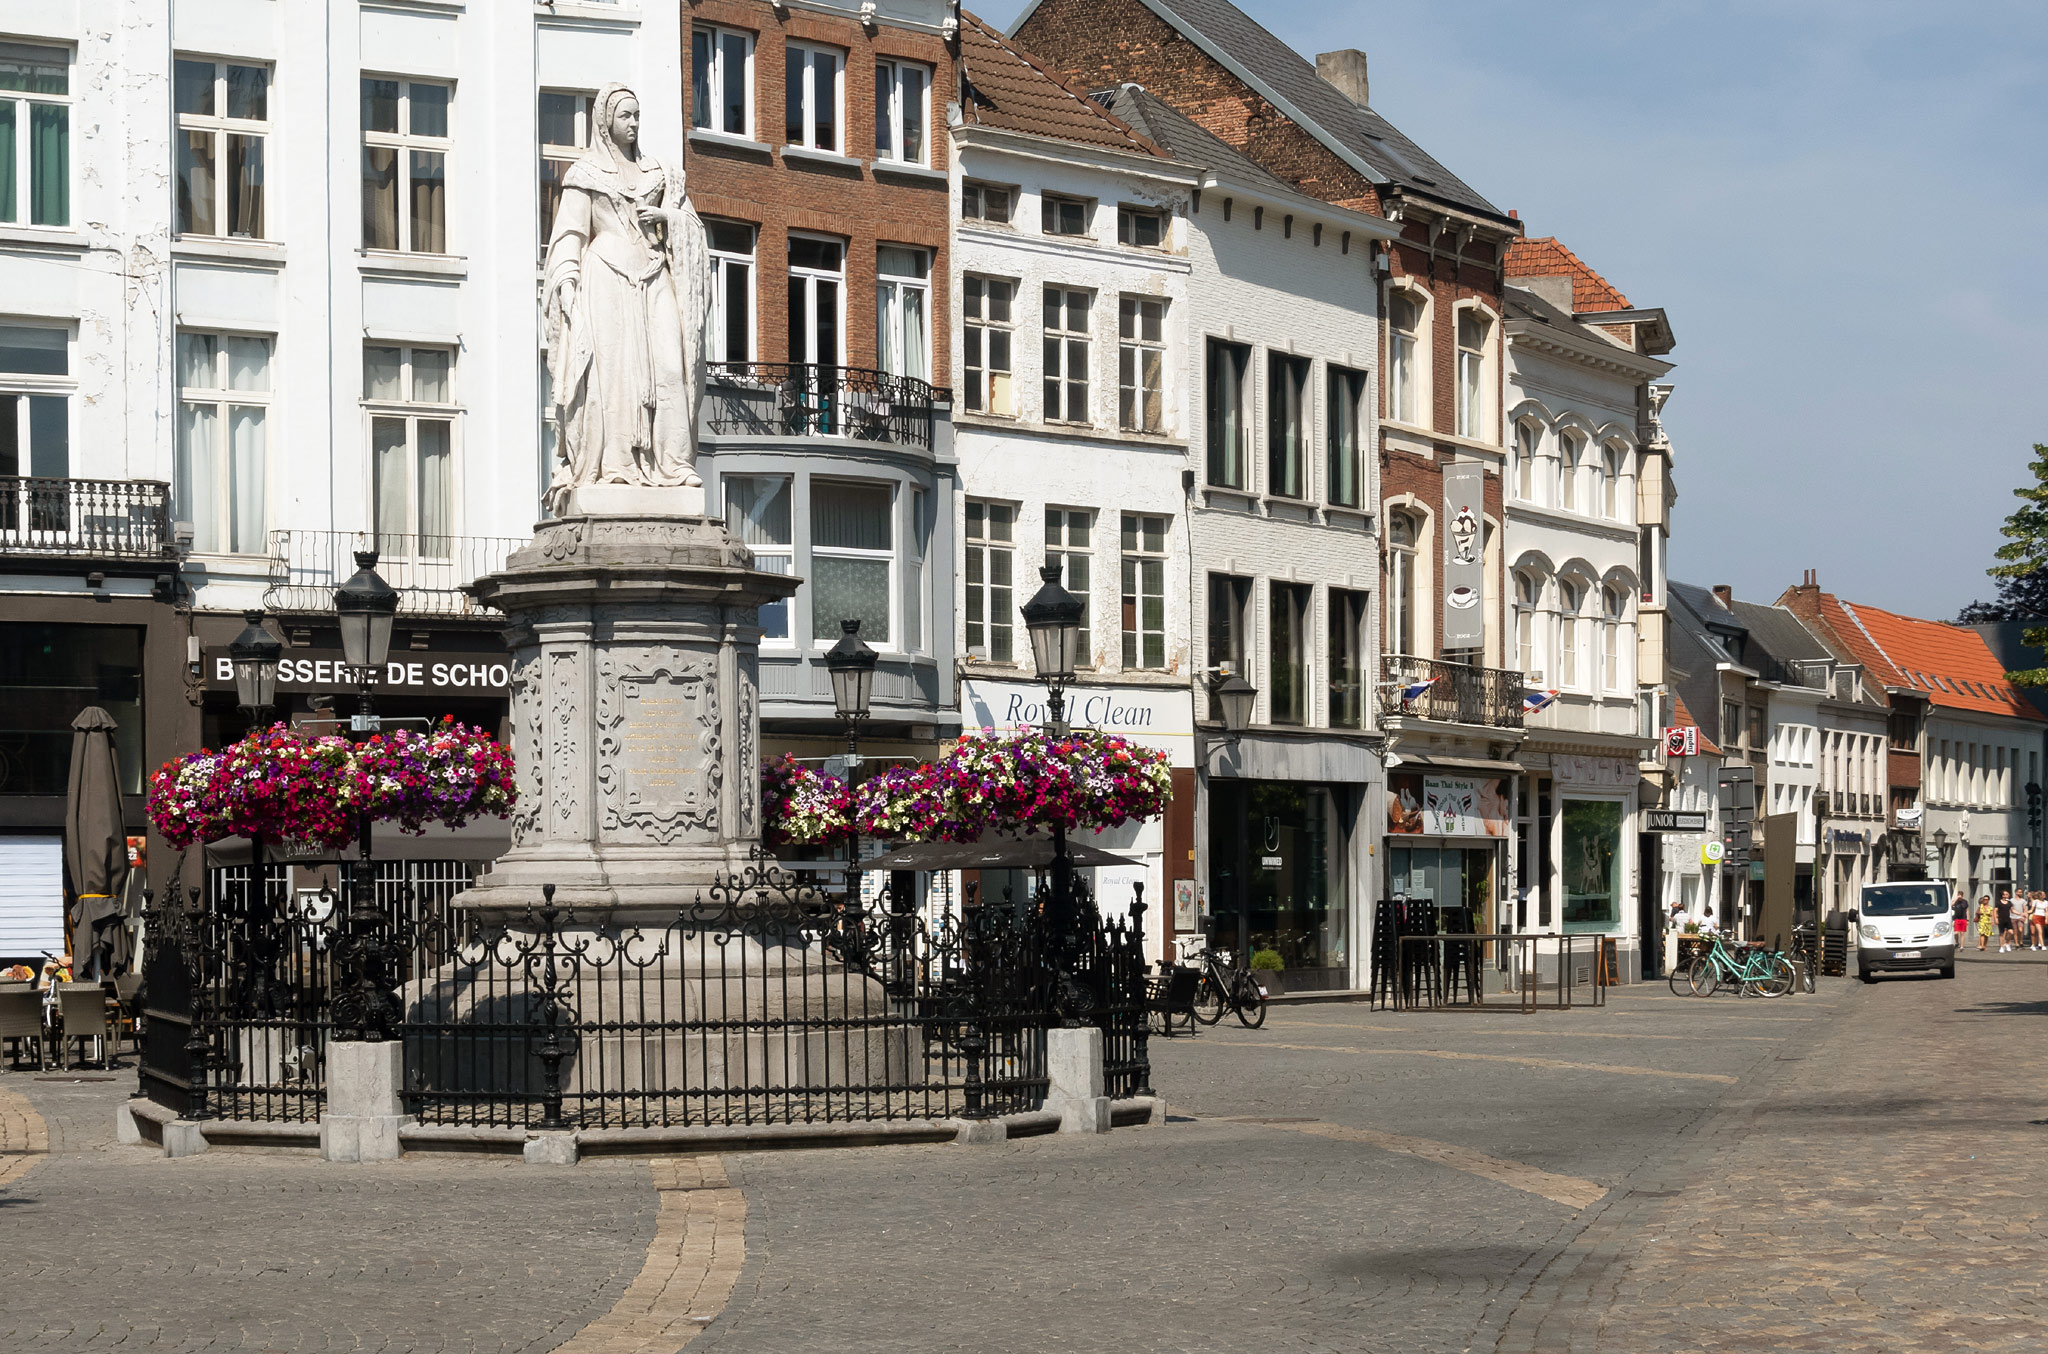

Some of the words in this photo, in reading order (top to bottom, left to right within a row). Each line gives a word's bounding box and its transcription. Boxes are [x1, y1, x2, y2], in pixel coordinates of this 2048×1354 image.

[216, 657, 379, 684] BSSERIE
[387, 663, 424, 685] DE
[1005, 693, 1075, 724] Royl
[1085, 695, 1152, 726] Clean
[1687, 728, 1695, 753] Jupiler
[1425, 779, 1439, 787] Baan
[1441, 780, 1453, 788] Thai
[1455, 781, 1468, 790] Style
[1647, 813, 1674, 828] JUNIOR
[1103, 876, 1121, 886] Royal
